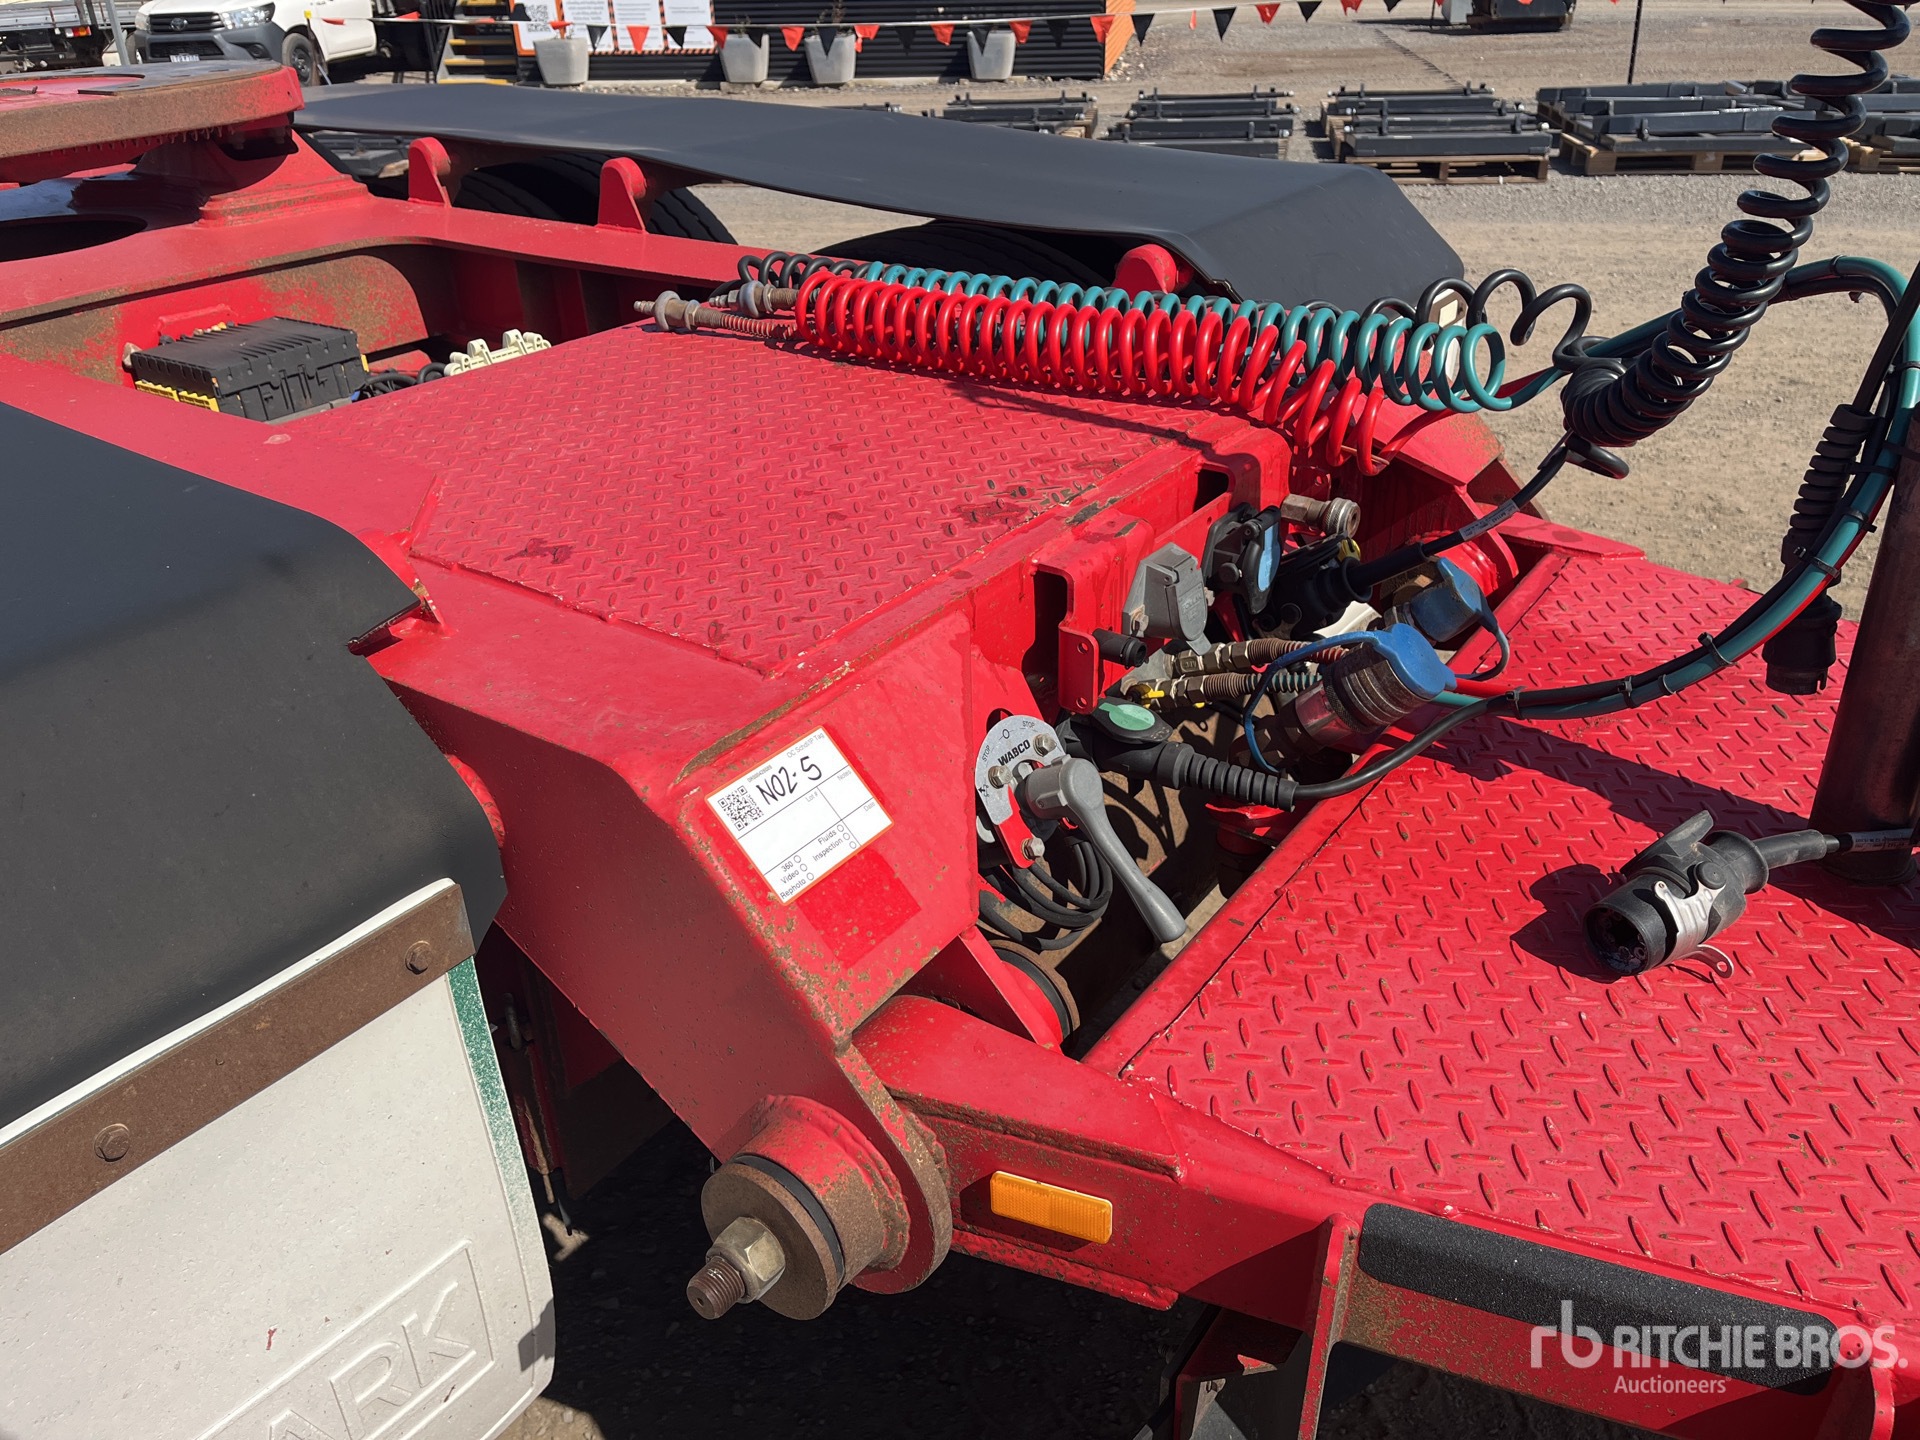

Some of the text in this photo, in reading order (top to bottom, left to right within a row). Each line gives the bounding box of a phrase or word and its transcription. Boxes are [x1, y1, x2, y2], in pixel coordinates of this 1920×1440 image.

[1022, 720, 1035, 729] STOP
[981, 745, 991, 762] STOP
[997, 739, 1031, 766] WABCO
[837, 770, 852, 781] Notes
[805, 793, 814, 803] Lot
[863, 801, 875, 812] Date
[817, 829, 837, 845] Fluids
[812, 838, 844, 862] Inspection
[781, 861, 794, 872] 360
[780, 870, 800, 884] Video
[779, 879, 806, 899] Rephoto
